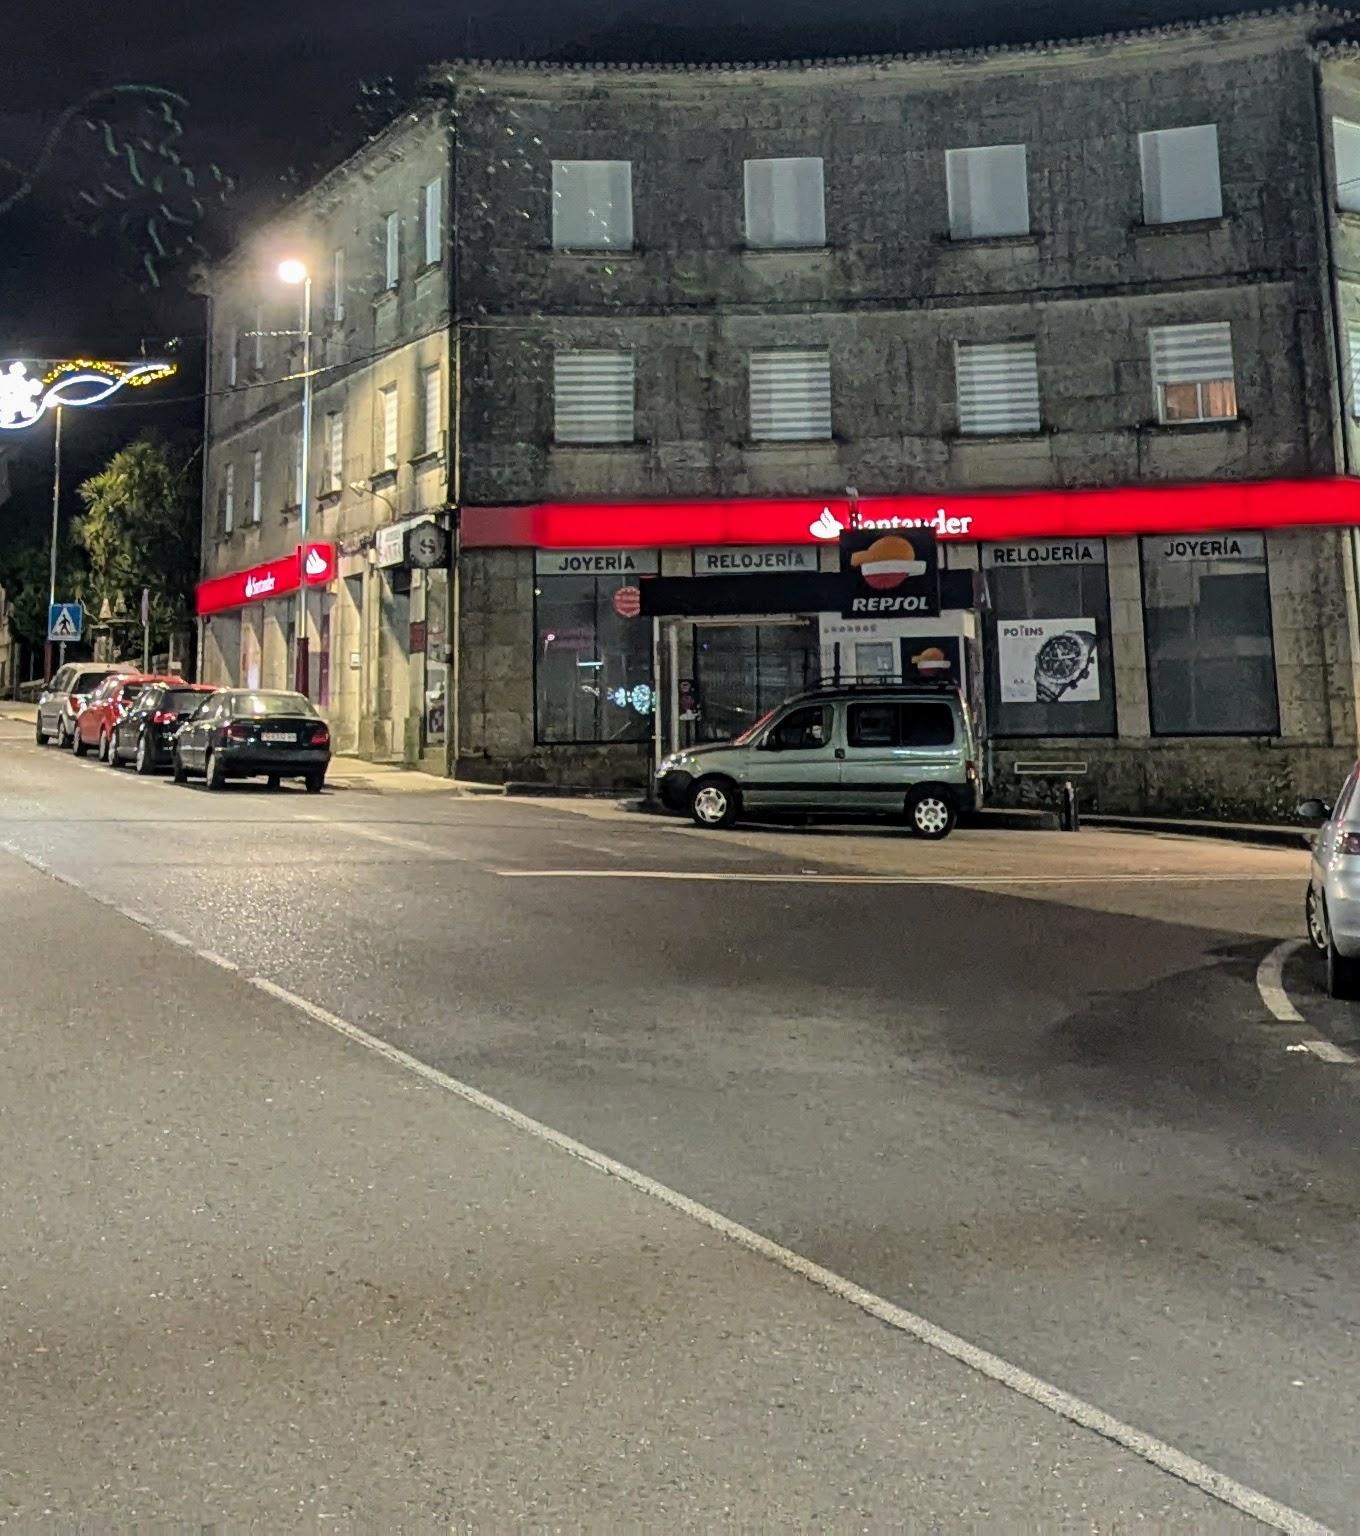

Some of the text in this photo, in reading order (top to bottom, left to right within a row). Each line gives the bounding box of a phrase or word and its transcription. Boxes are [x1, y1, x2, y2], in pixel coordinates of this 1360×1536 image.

[993, 542, 1093, 563] RELOJERÍA
[1164, 536, 1242, 557] JOYERÍA
[558, 554, 635, 571] JOYERÍA
[707, 549, 805, 569] RELOJERÍA
[852, 596, 929, 612] REPSOL
[1003, 625, 1044, 637] POTENS
